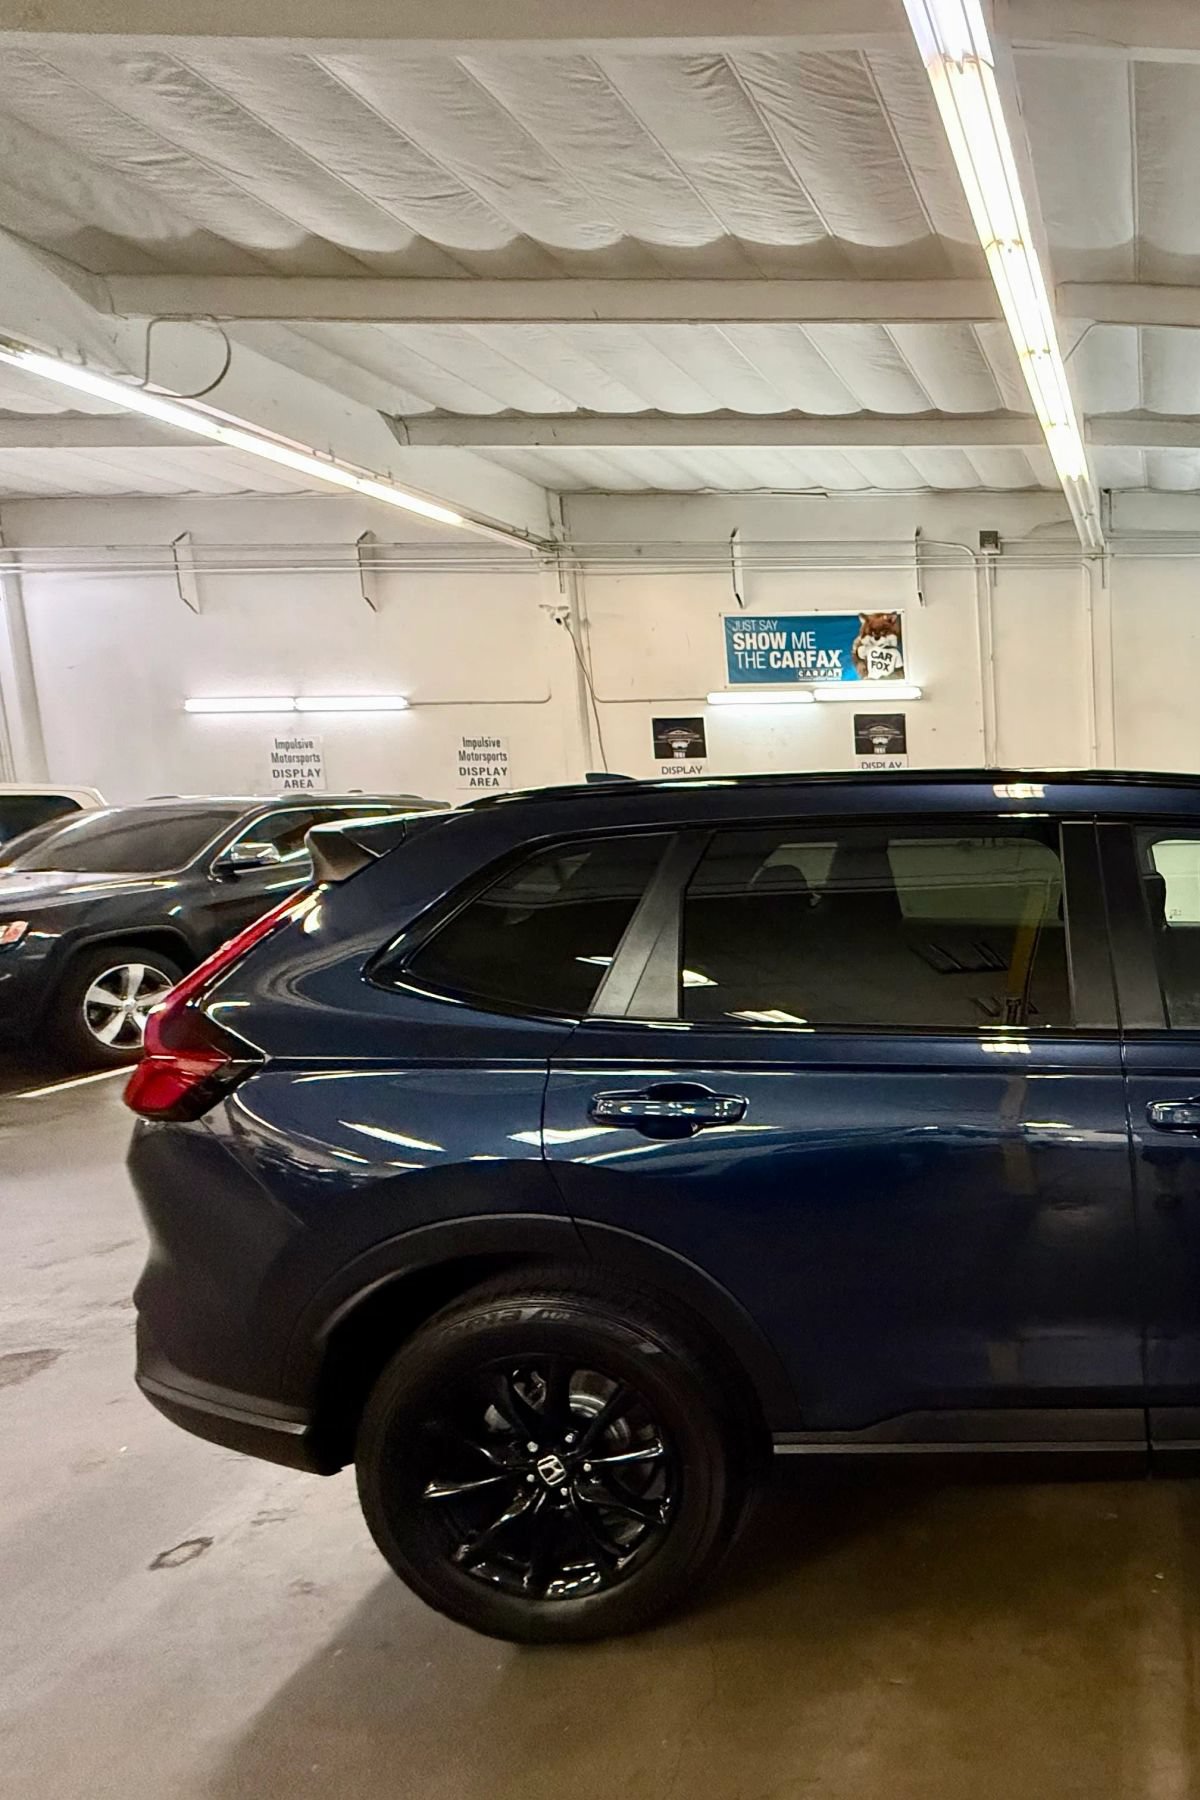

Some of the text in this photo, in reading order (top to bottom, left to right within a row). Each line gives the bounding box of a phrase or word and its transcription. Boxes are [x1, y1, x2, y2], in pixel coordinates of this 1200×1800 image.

[732, 620, 778, 631] JUST SAY
[733, 632, 816, 650] SHOW ME
[734, 650, 842, 669] THE CARFAX
[871, 650, 893, 662] CAR
[871, 661, 890, 672] FOX
[274, 738, 314, 752] Impulsive
[462, 737, 501, 750] Impulsive
[271, 752, 321, 765] Motorsports
[458, 750, 508, 764] Motorsports
[272, 768, 321, 778] DISPLAY
[459, 767, 508, 776] DISPLAY
[661, 766, 703, 775] DISPLAY
[284, 779, 314, 789] AREA
[469, 777, 500, 787] AREA
